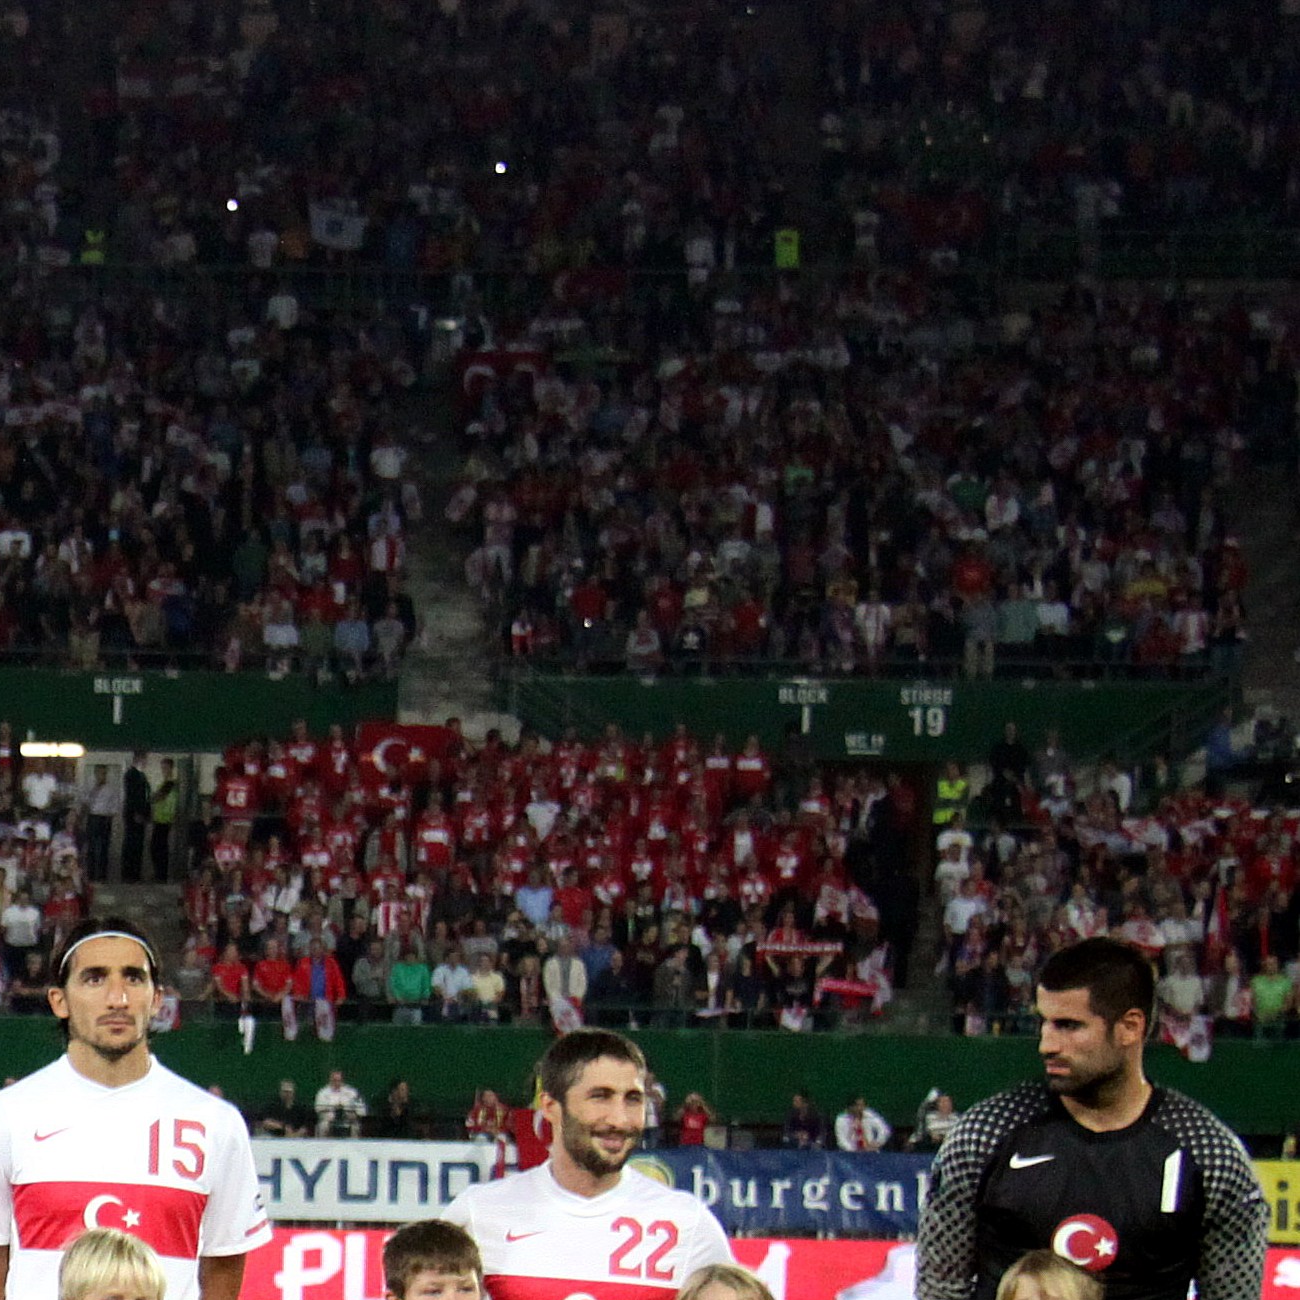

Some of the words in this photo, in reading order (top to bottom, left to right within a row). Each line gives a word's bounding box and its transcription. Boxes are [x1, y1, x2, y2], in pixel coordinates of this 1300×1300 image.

[93, 677, 143, 694] BLOCK
[909, 707, 945, 737] 19
[149, 1118, 206, 1180] 15
[1161, 1149, 1182, 1213] 1
[609, 1215, 679, 1281] 22
